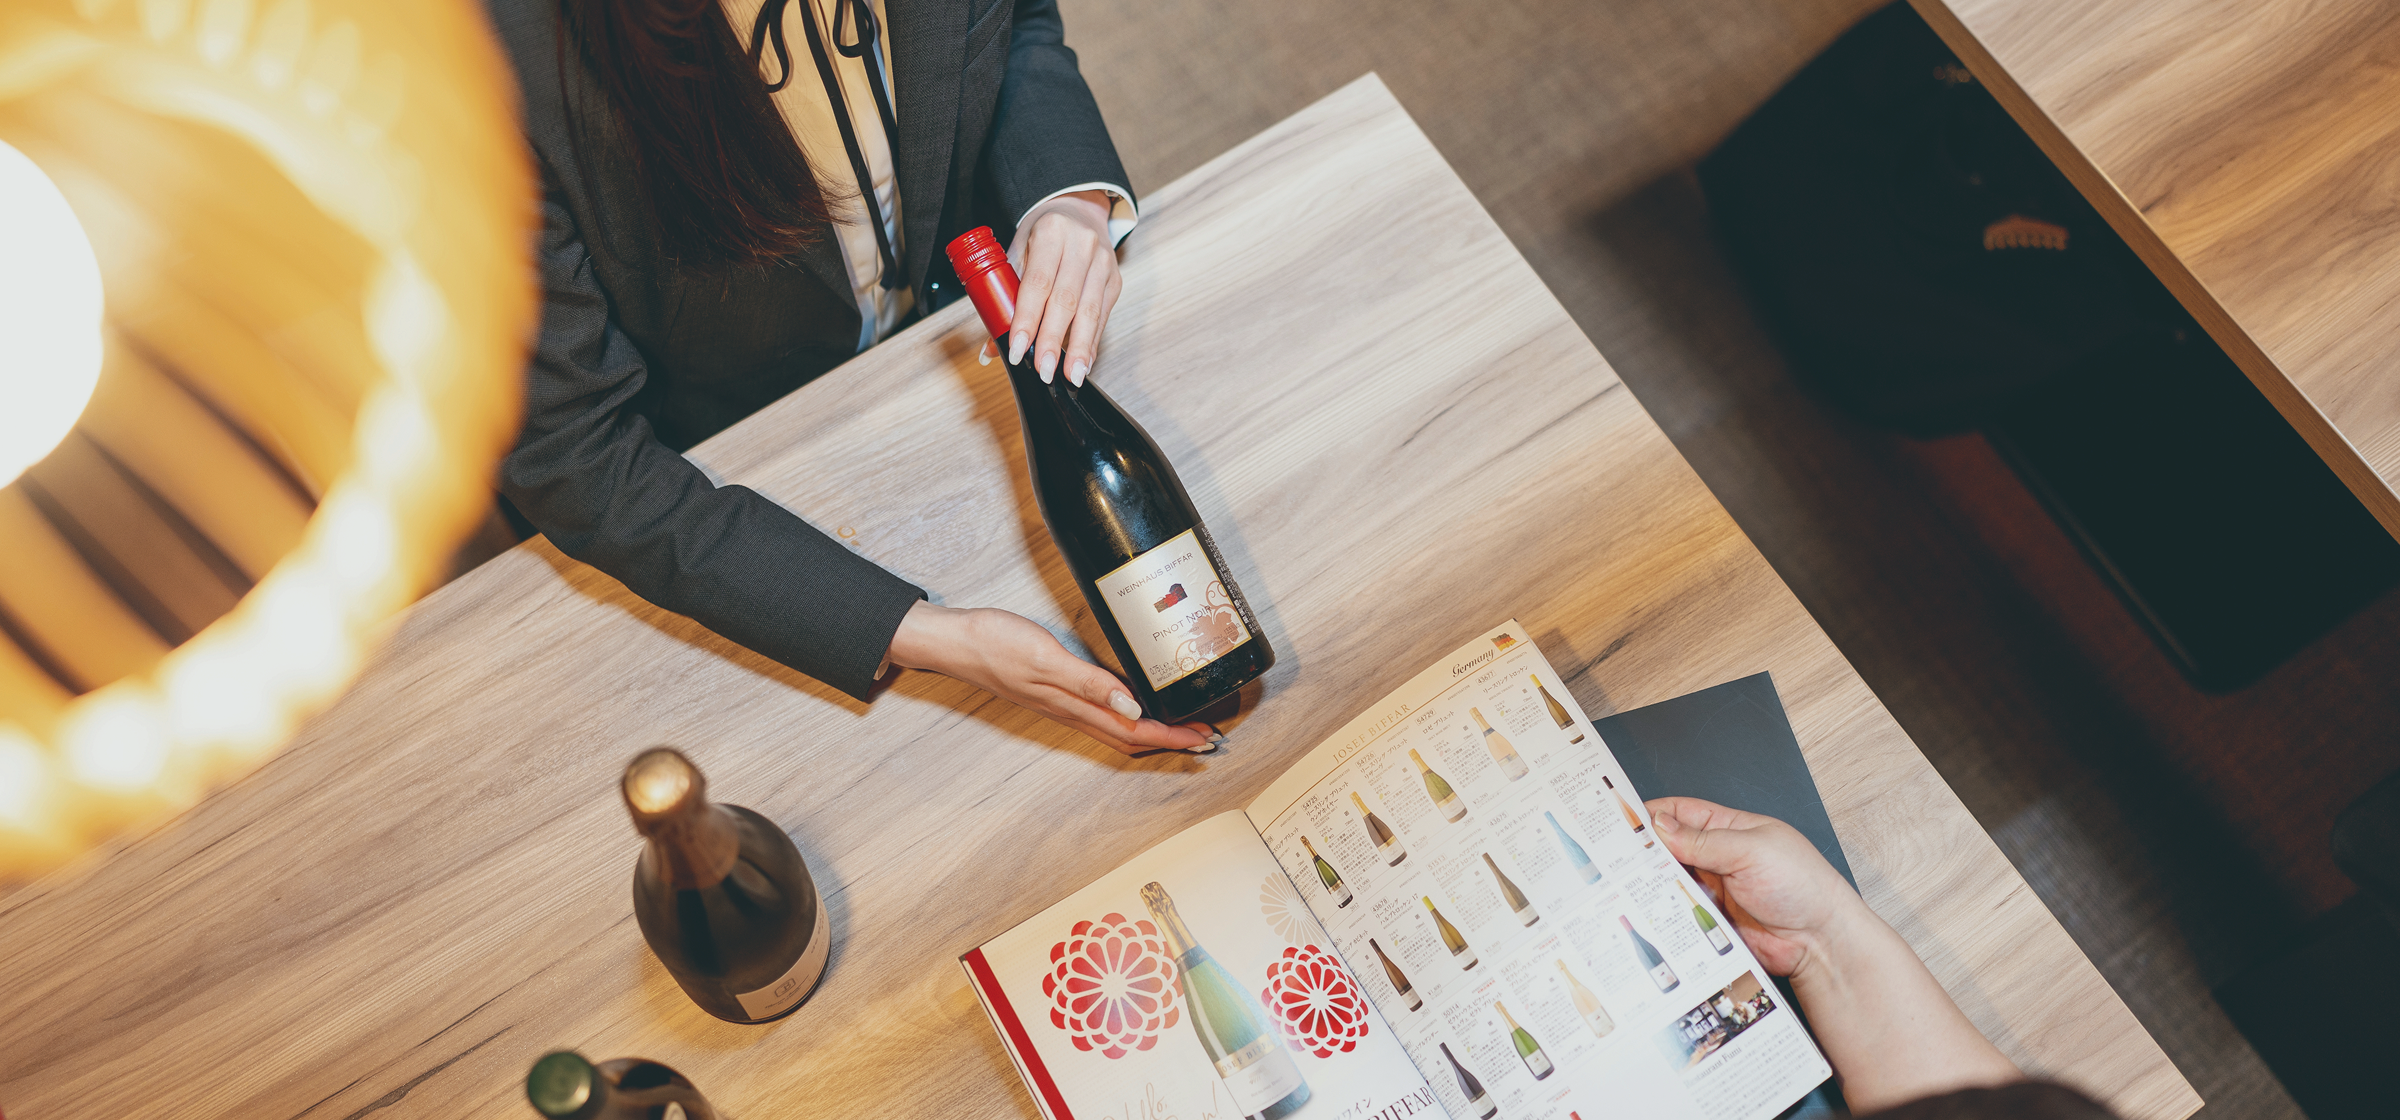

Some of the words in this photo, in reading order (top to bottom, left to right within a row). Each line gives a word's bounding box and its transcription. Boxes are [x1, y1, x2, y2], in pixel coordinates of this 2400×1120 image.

[1117, 569, 1164, 598] WEINHAUS
[1164, 552, 1194, 572] BIFFAR
[1153, 619, 1186, 642] PINOT
[1186, 604, 1212, 624] NOIR
[1452, 649, 1495, 677] Germany
[1417, 710, 1435, 725] 54729
[1333, 734, 1366, 764] JOSEF
[1368, 704, 1410, 736] BIFFAR
[1356, 753, 1375, 767] 54726
[1428, 856, 1446, 870] 51513
[1721, 1045, 1743, 1063] Fumi
